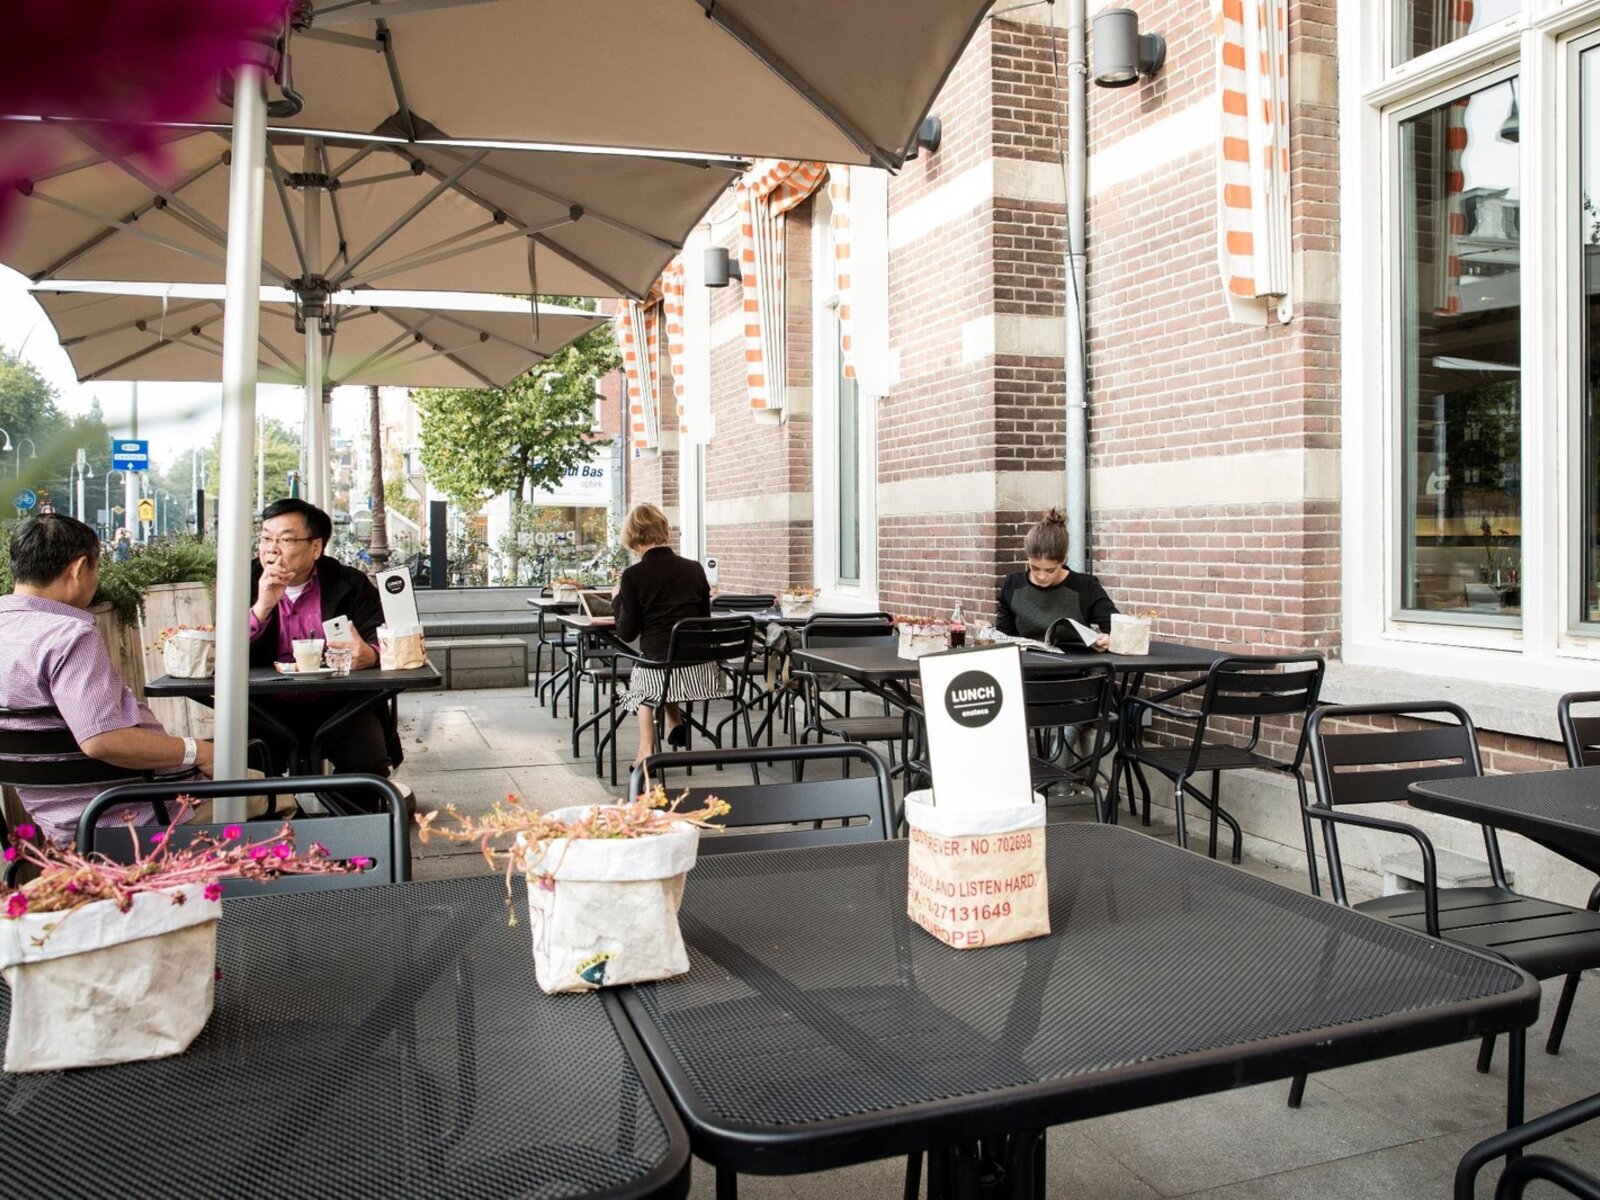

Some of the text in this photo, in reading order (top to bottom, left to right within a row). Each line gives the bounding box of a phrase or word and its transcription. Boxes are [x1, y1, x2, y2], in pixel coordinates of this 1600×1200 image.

[582, 465, 604, 478] Bas
[951, 686, 996, 703] LUNCH
[970, 839, 990, 855] NO
[936, 879, 956, 898] AND
[959, 879, 1002, 898] LISTEN
